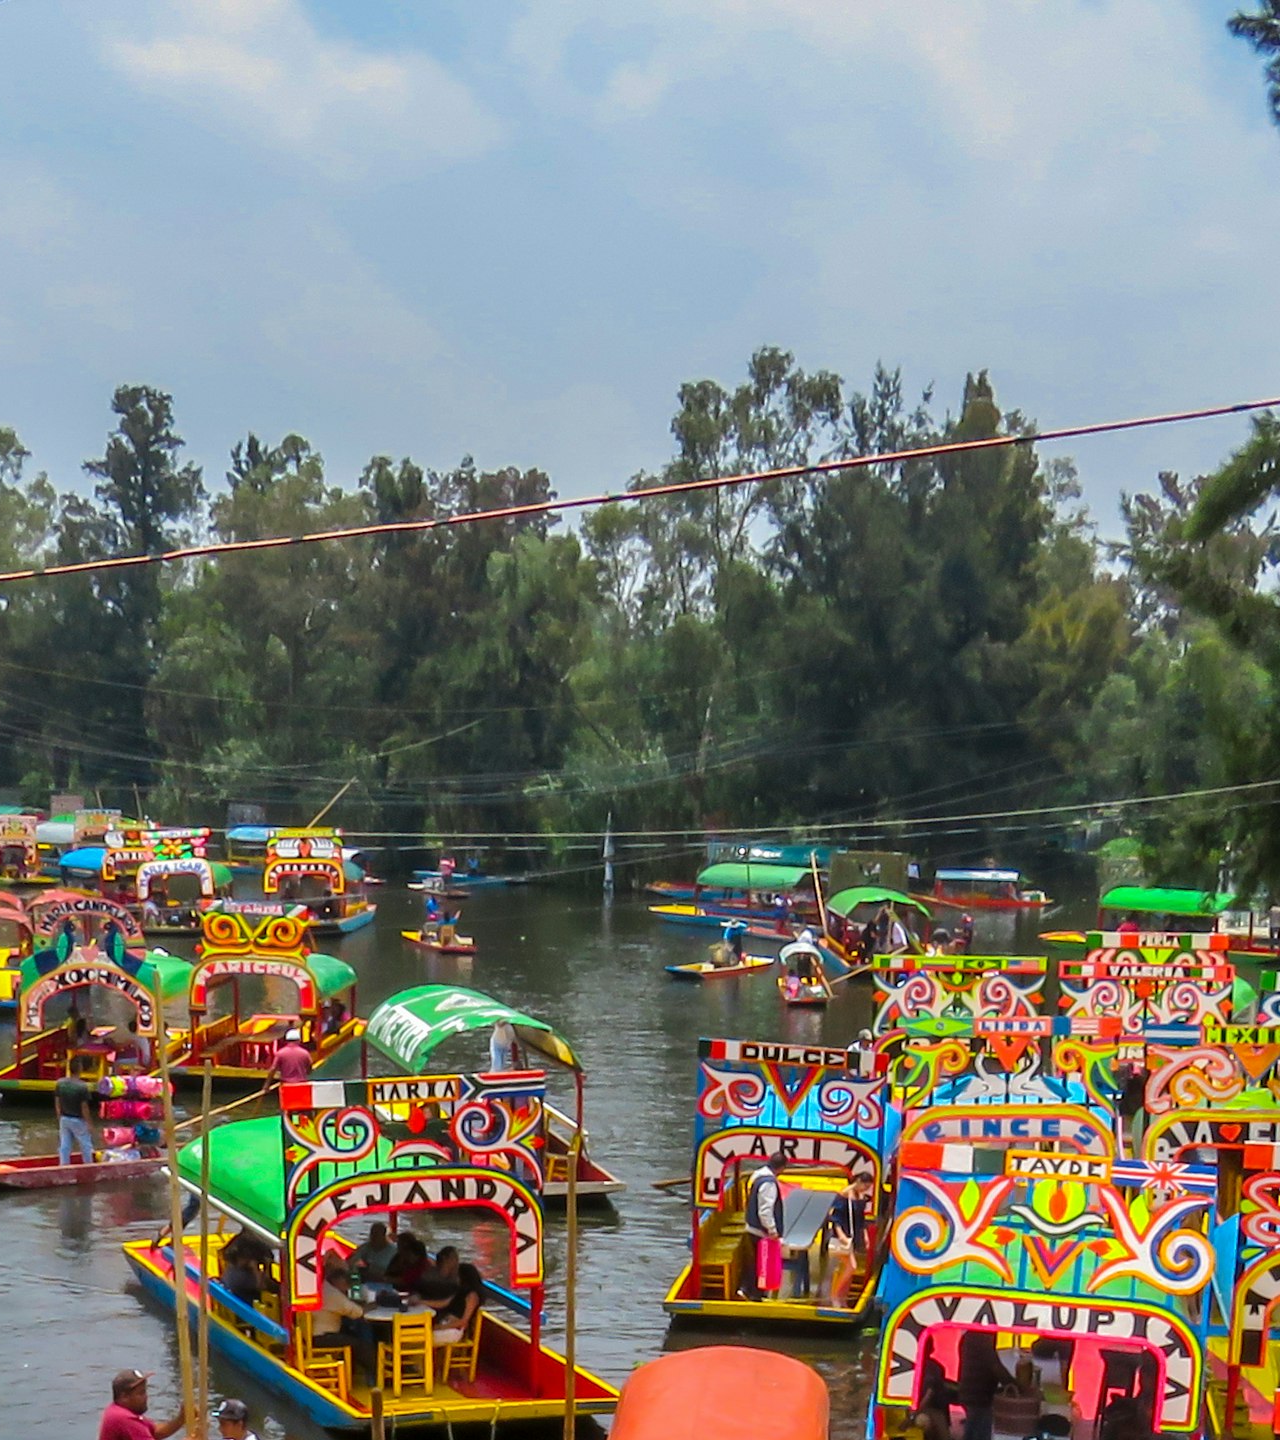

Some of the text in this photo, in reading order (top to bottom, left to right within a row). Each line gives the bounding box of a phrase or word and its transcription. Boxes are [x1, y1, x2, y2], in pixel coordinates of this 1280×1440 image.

[1138, 935, 1181, 947] PERLA
[195, 961, 308, 988] MARICRUZ
[1108, 965, 1185, 978] VALERIA
[981, 1020, 1043, 1032] LINDA
[742, 1044, 845, 1065] DULCE
[373, 1081, 455, 1102] MARIA
[1012, 1156, 1106, 1178] TAYDE
[296, 1178, 538, 1275] ALEJANDRA
